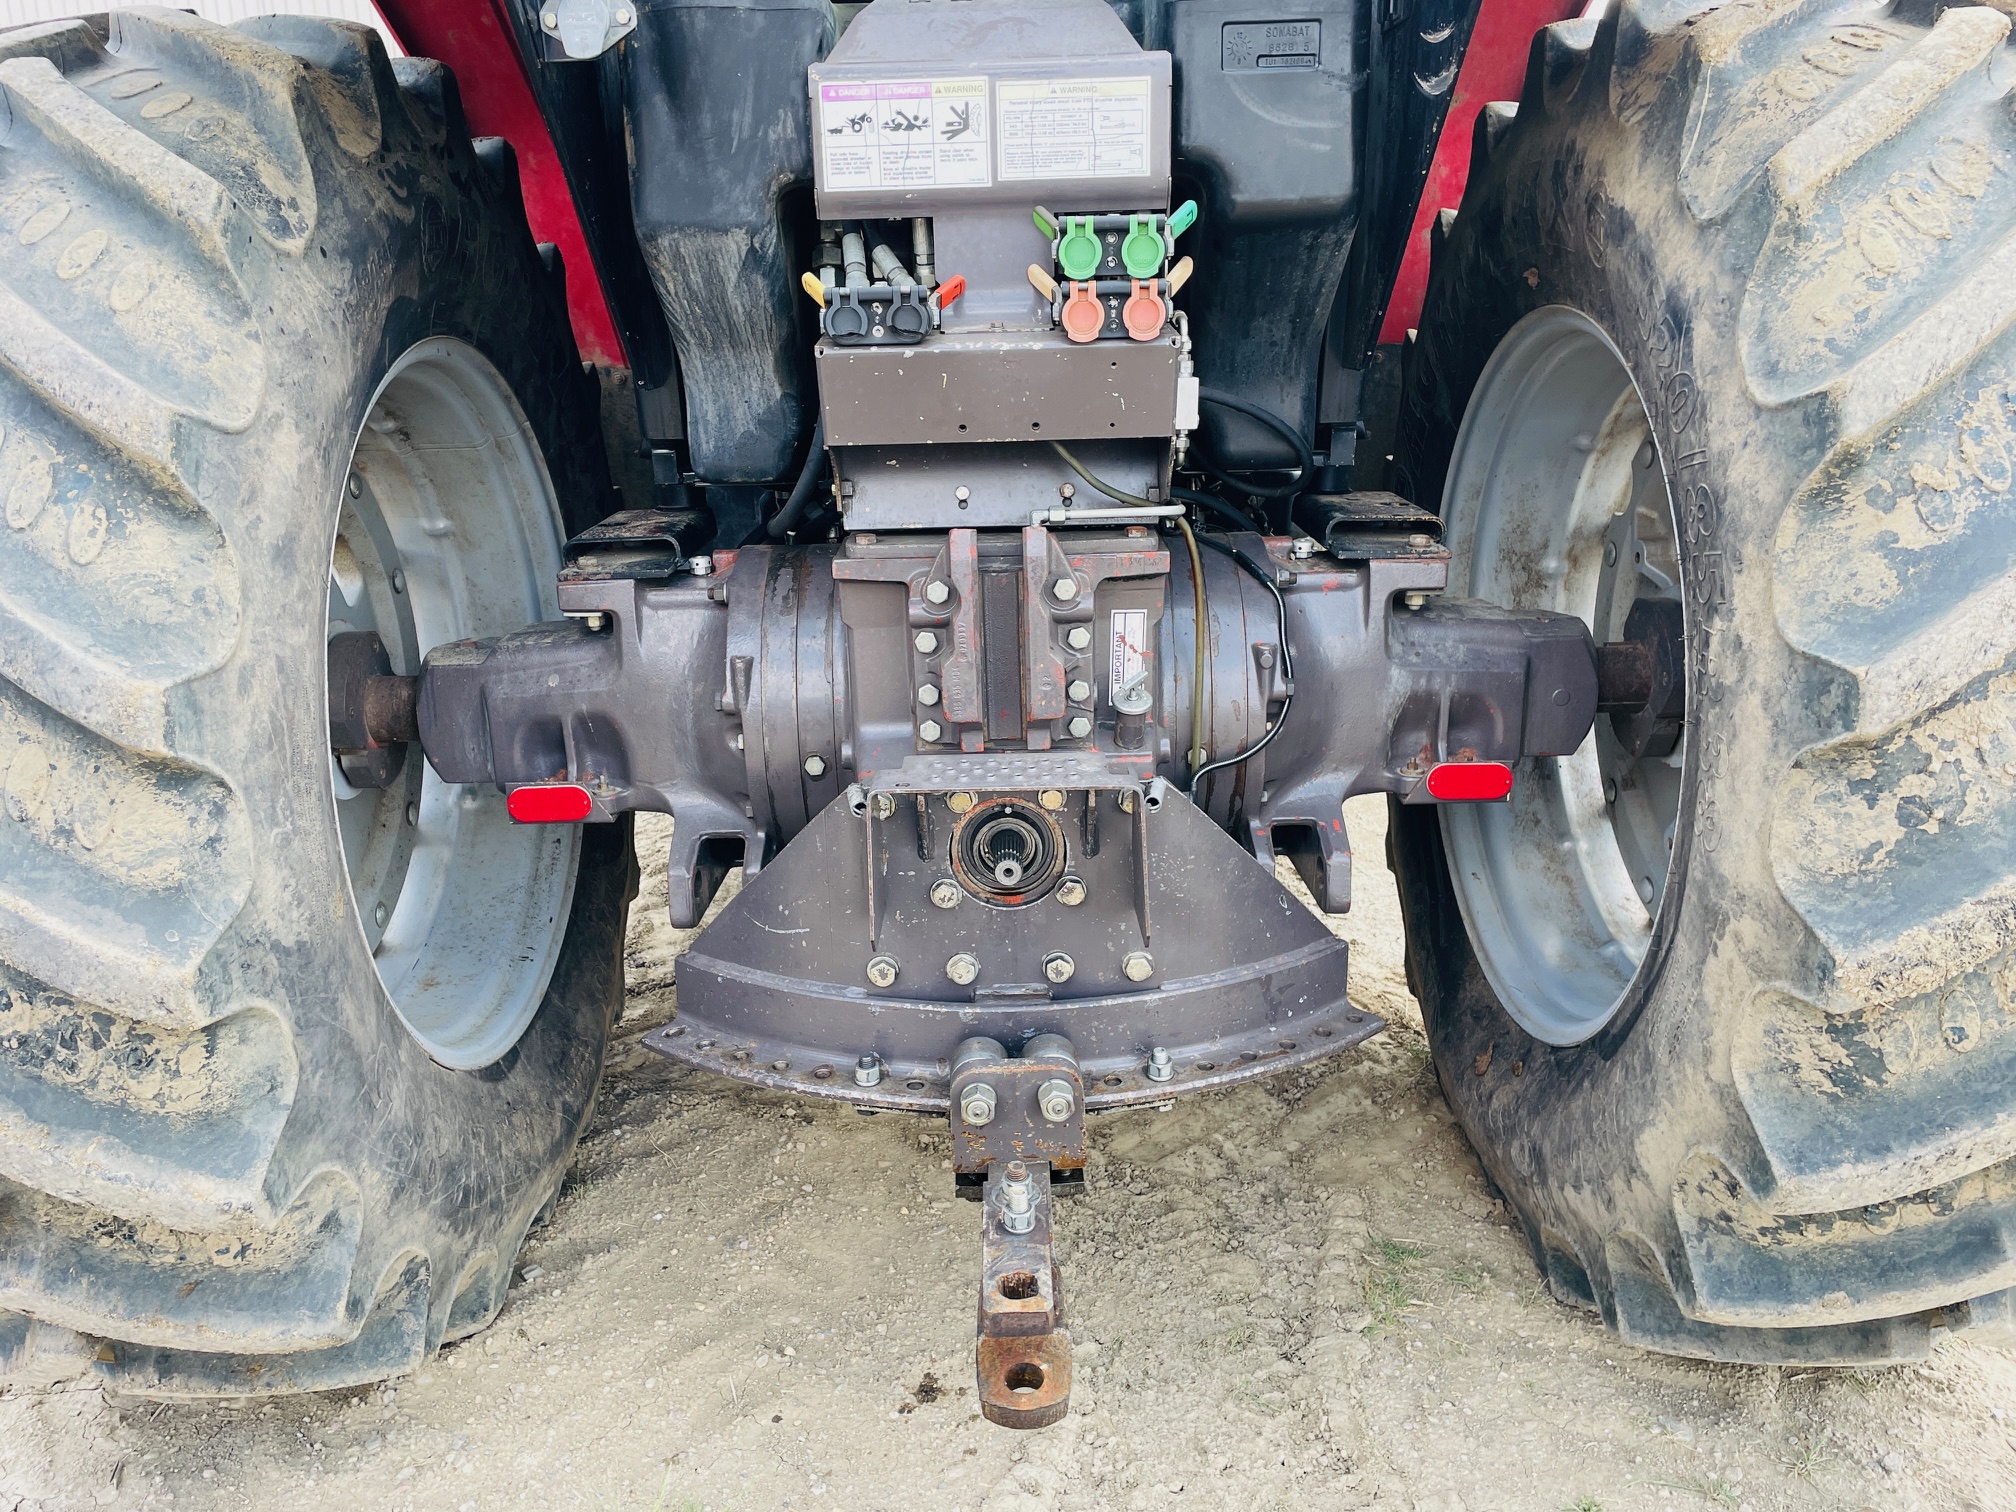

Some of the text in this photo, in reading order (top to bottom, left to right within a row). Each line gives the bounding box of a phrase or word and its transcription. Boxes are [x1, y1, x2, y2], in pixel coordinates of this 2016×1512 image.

[1303, 42, 1310, 52] 5
[943, 84, 984, 93] WARNING
[1060, 86, 1098, 94] WARNING
